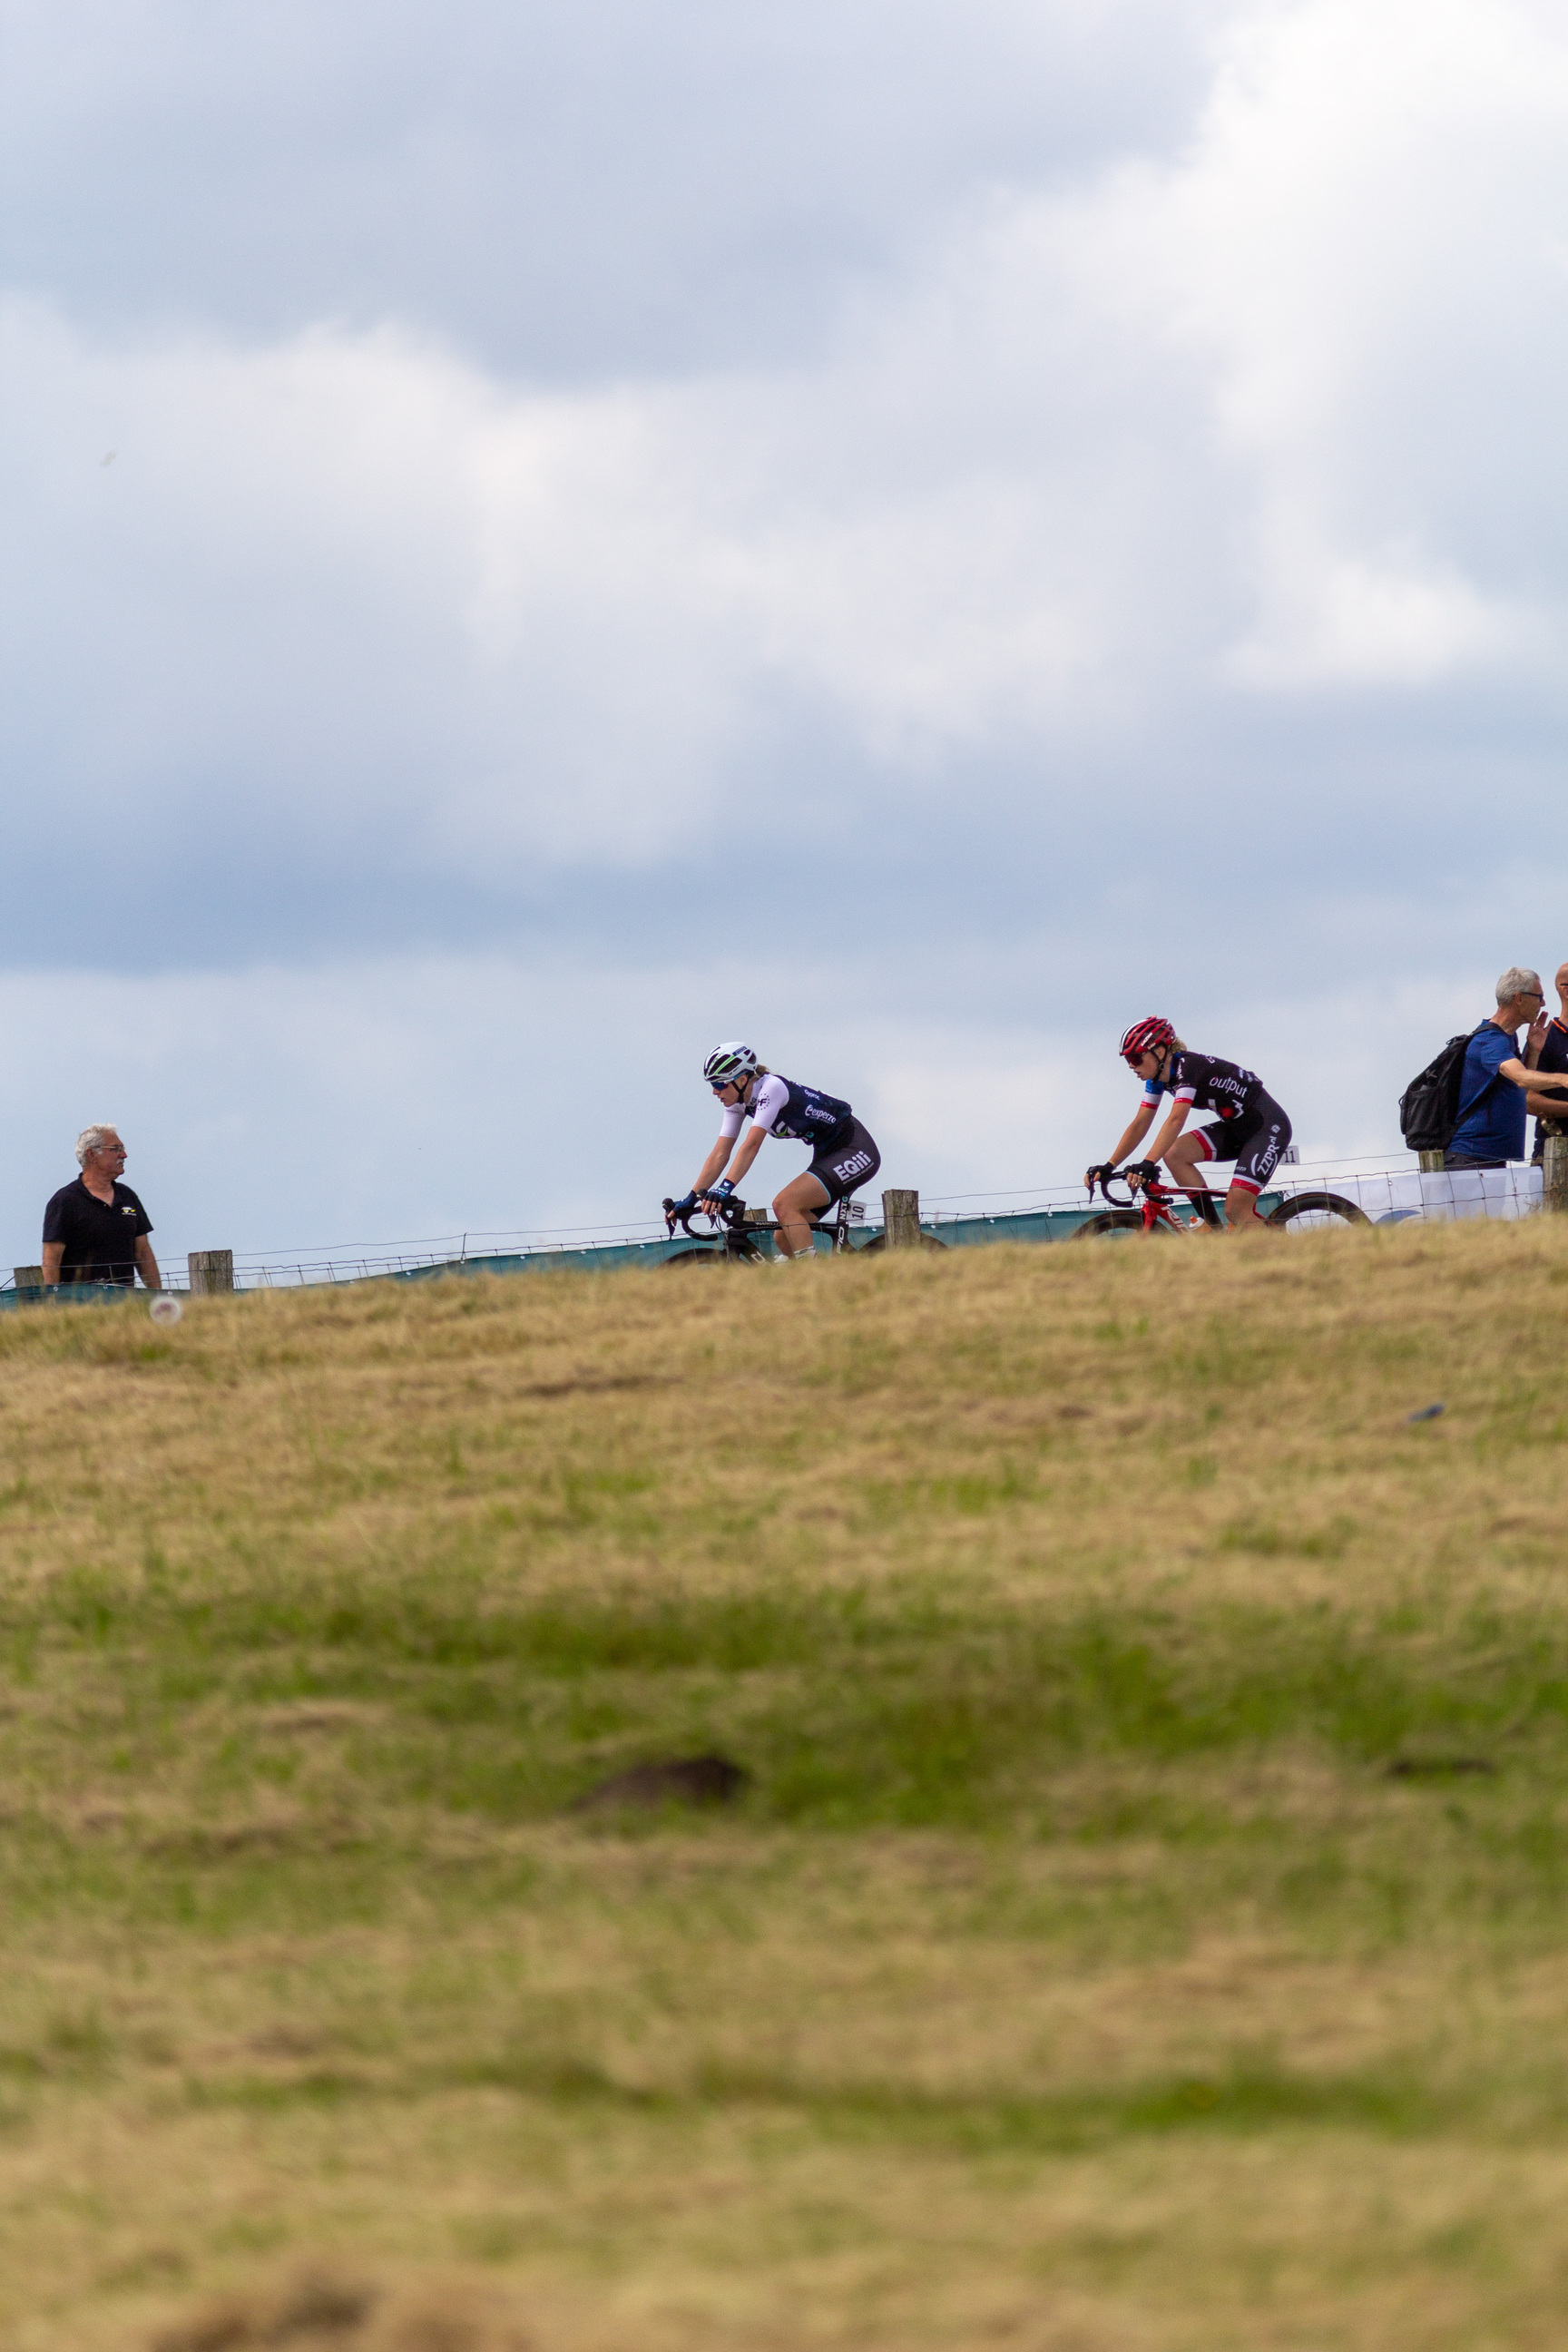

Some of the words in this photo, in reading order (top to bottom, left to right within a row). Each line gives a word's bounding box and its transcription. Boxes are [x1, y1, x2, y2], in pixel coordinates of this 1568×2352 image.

[1210, 1076, 1249, 1099] output
[832, 1151, 872, 1181] EQili
[1284, 1150, 1296, 1163] 11
[838, 1195, 848, 1220] NXTG
[851, 1205, 865, 1220] 10
